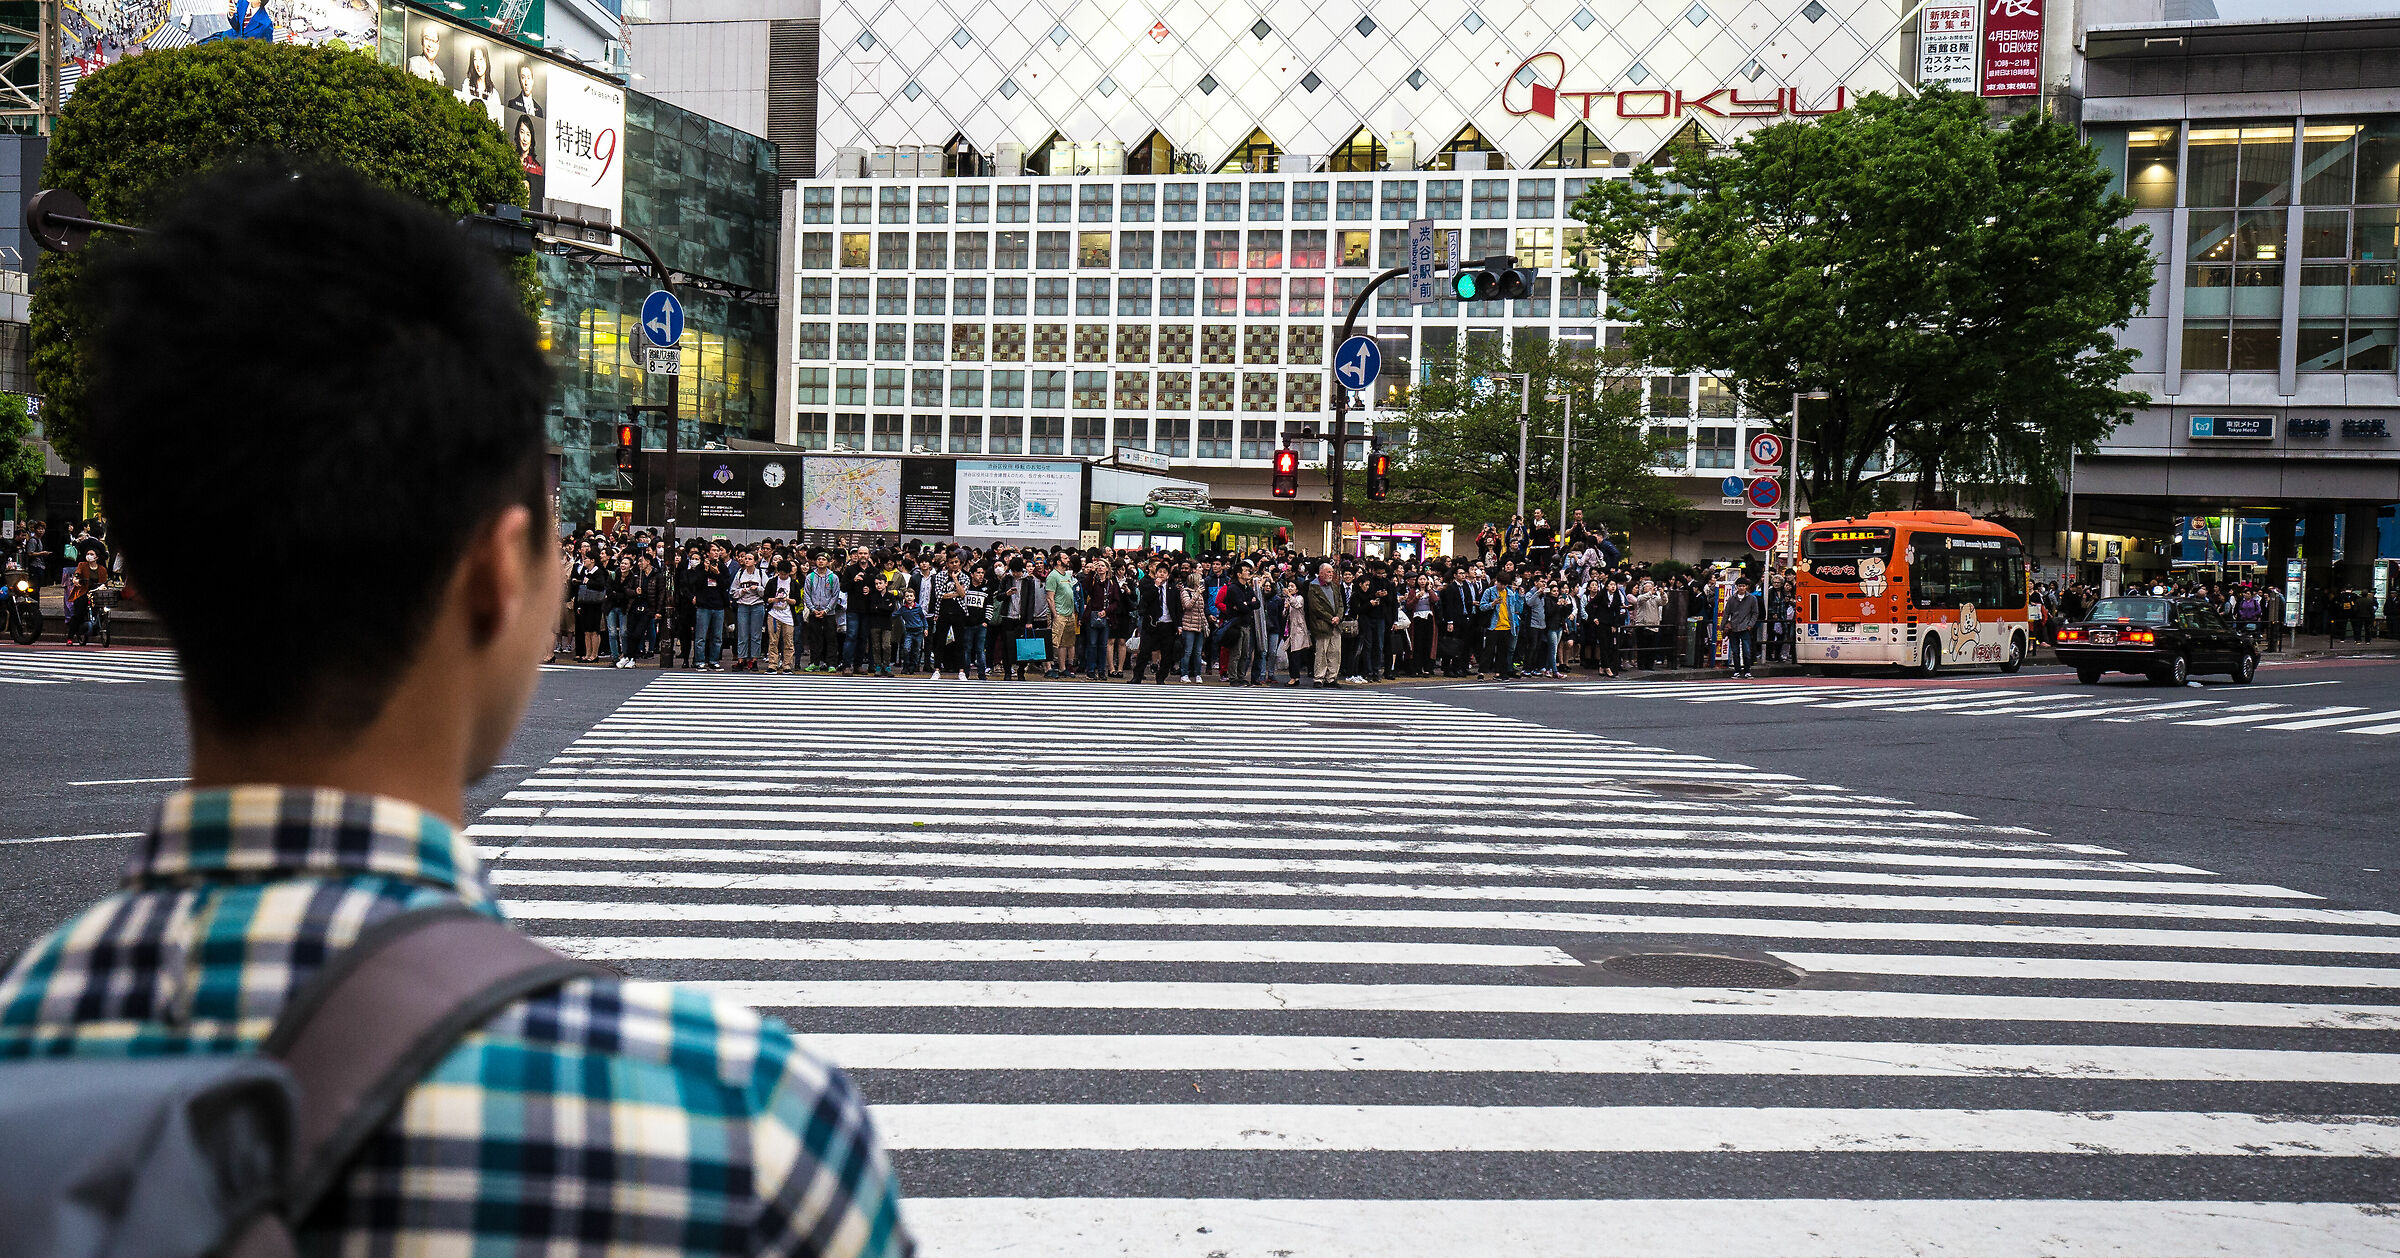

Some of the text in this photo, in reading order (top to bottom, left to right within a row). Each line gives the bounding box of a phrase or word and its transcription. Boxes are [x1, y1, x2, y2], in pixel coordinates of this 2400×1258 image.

[1930, 10, 1970, 20] 新規会員
[1930, 20, 1971, 30] 募集中
[1927, 43, 1970, 53] 西館8階
[1924, 56, 1971, 65] カスタマー
[1924, 64, 1971, 73] センターへ
[1986, 82, 2037, 91] 東急東横店
[1559, 85, 1845, 120] TOKYU
[1411, 238, 1419, 271] Shibuya
[1420, 226, 1431, 298] 渋谷駅前
[2226, 420, 2260, 428] 東京メトロ
[1816, 565, 1857, 576] ハチ公バス
